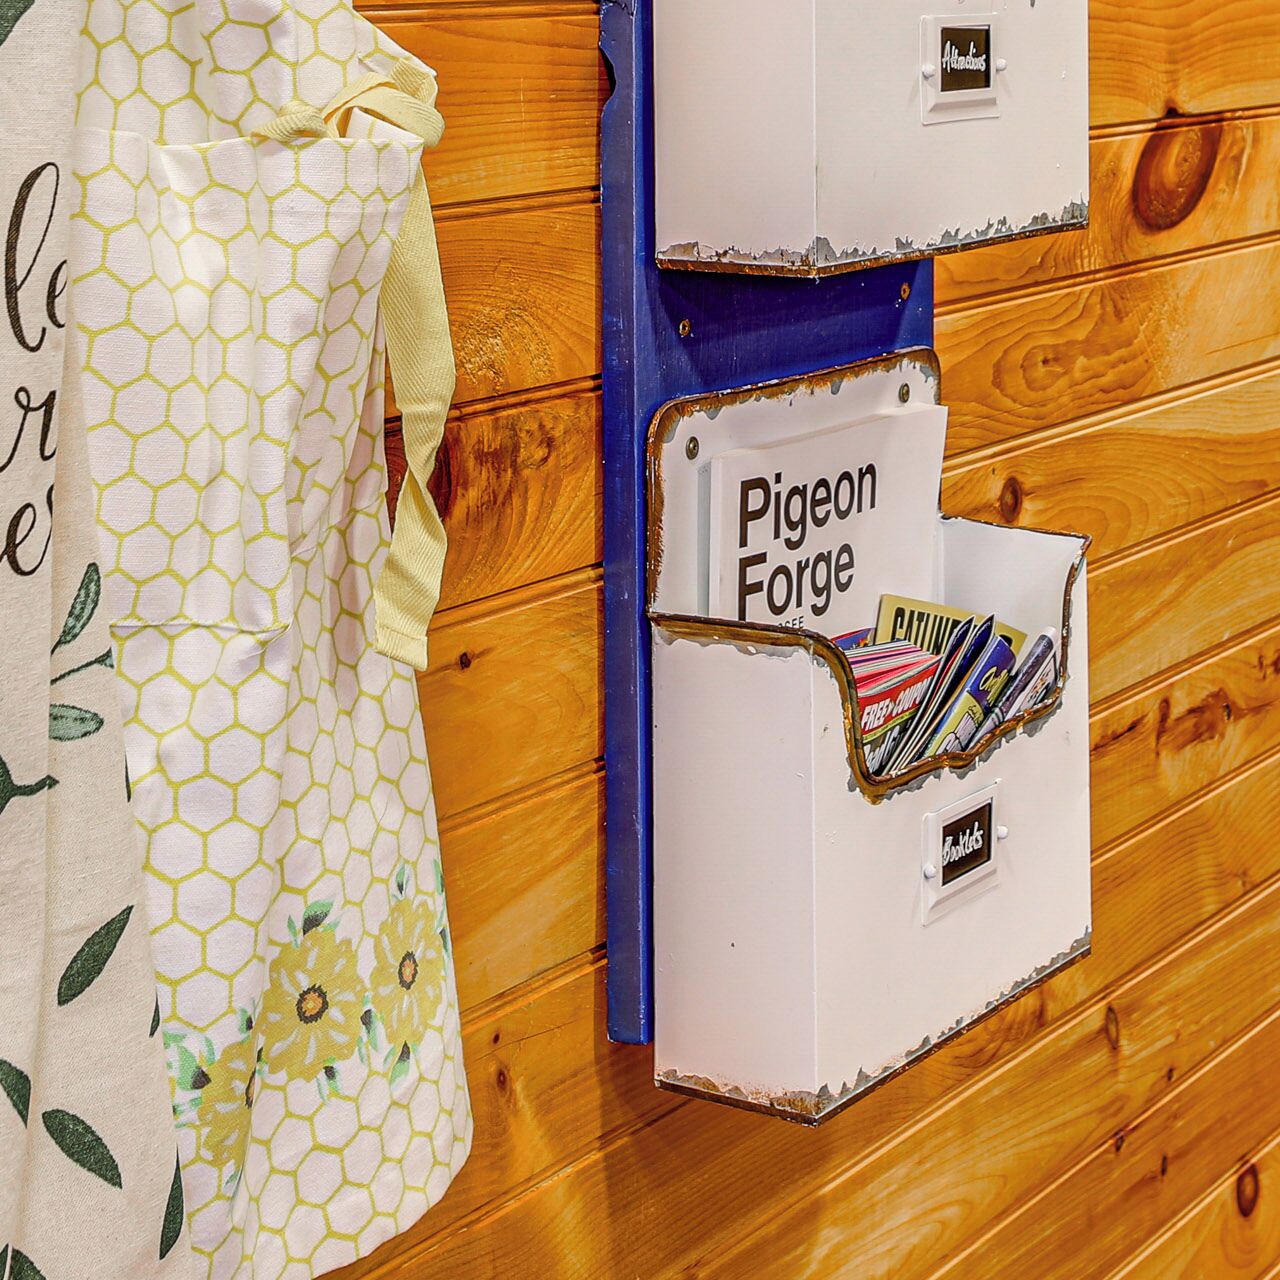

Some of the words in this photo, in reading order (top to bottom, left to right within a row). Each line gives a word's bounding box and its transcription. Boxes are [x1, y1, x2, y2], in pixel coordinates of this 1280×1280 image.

[739, 463, 877, 551] Pigeon
[738, 543, 855, 621] Forge
[861, 698, 891, 731] FREE
[942, 821, 984, 866] Booklets
